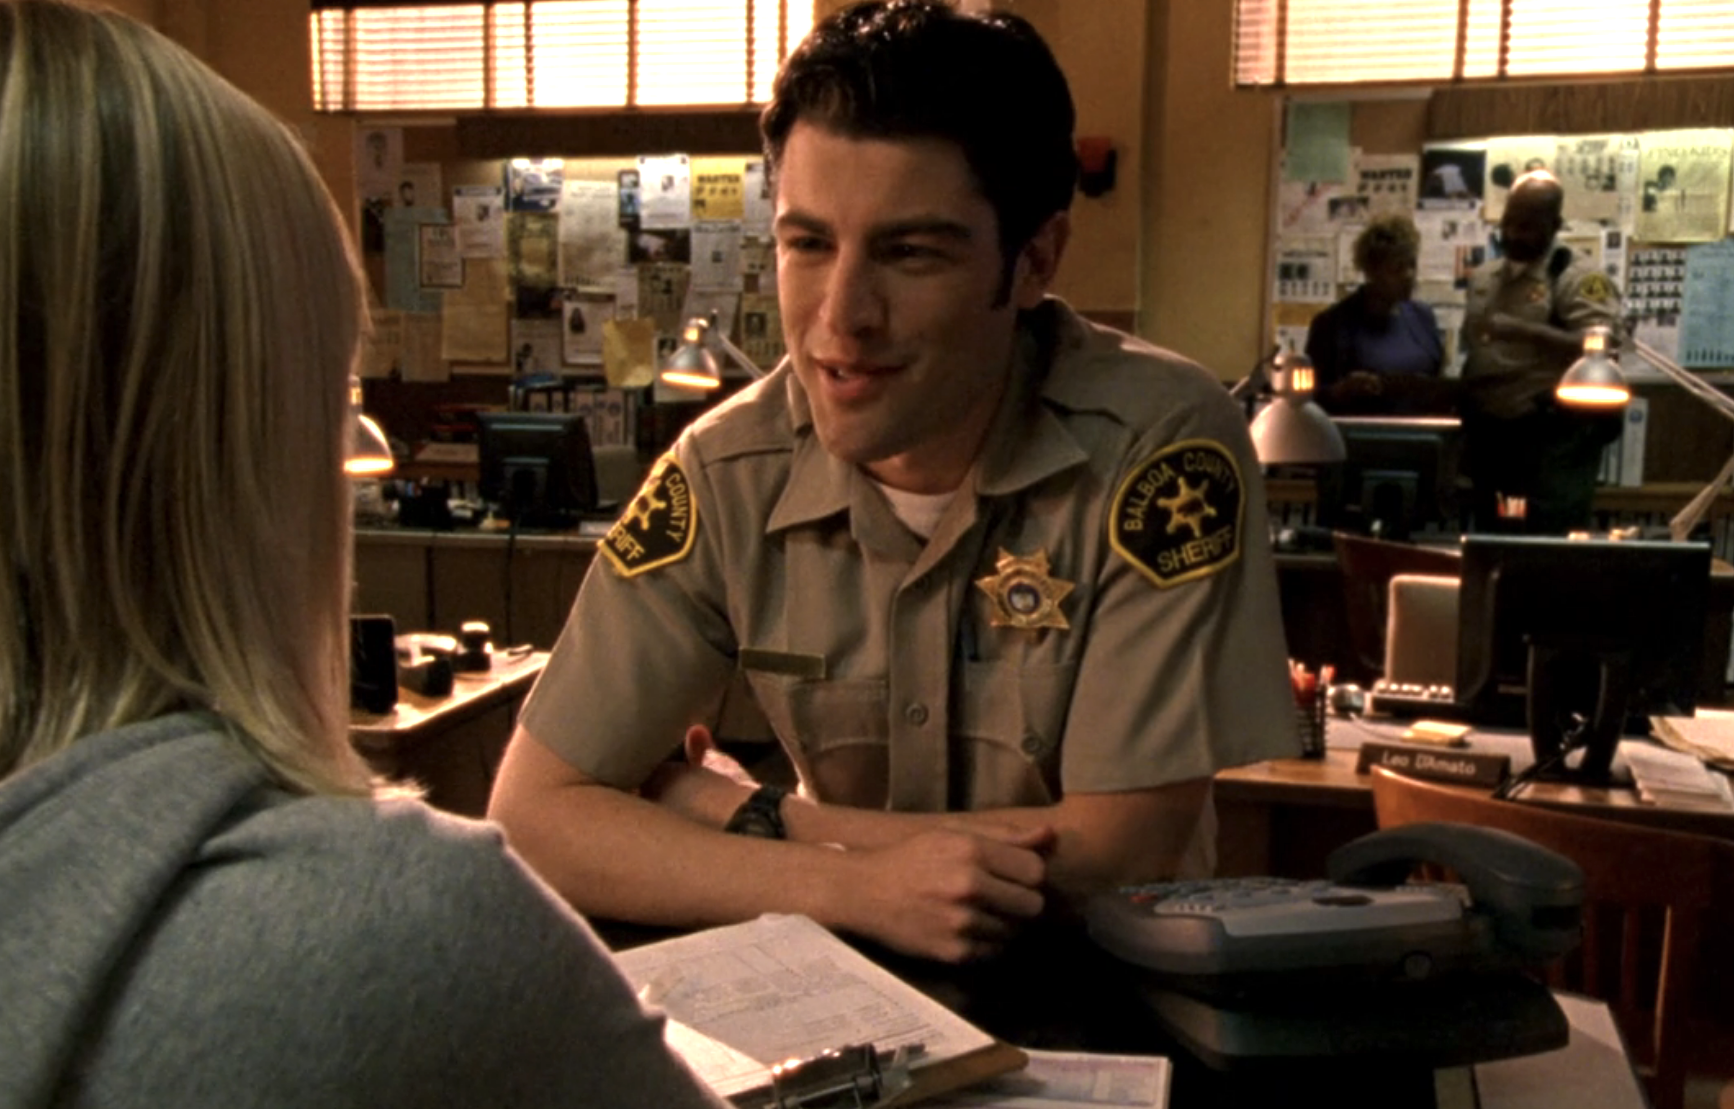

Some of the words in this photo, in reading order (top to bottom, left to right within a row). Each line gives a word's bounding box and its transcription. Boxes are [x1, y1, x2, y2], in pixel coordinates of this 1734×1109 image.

[665, 473, 688, 542] COUNTY
[1123, 462, 1175, 531] BALBOA
[1183, 451, 1235, 494] COUNTY
[608, 523, 645, 560] RIFF
[1157, 525, 1232, 572] SHERIFF
[1382, 751, 1410, 766] Leo
